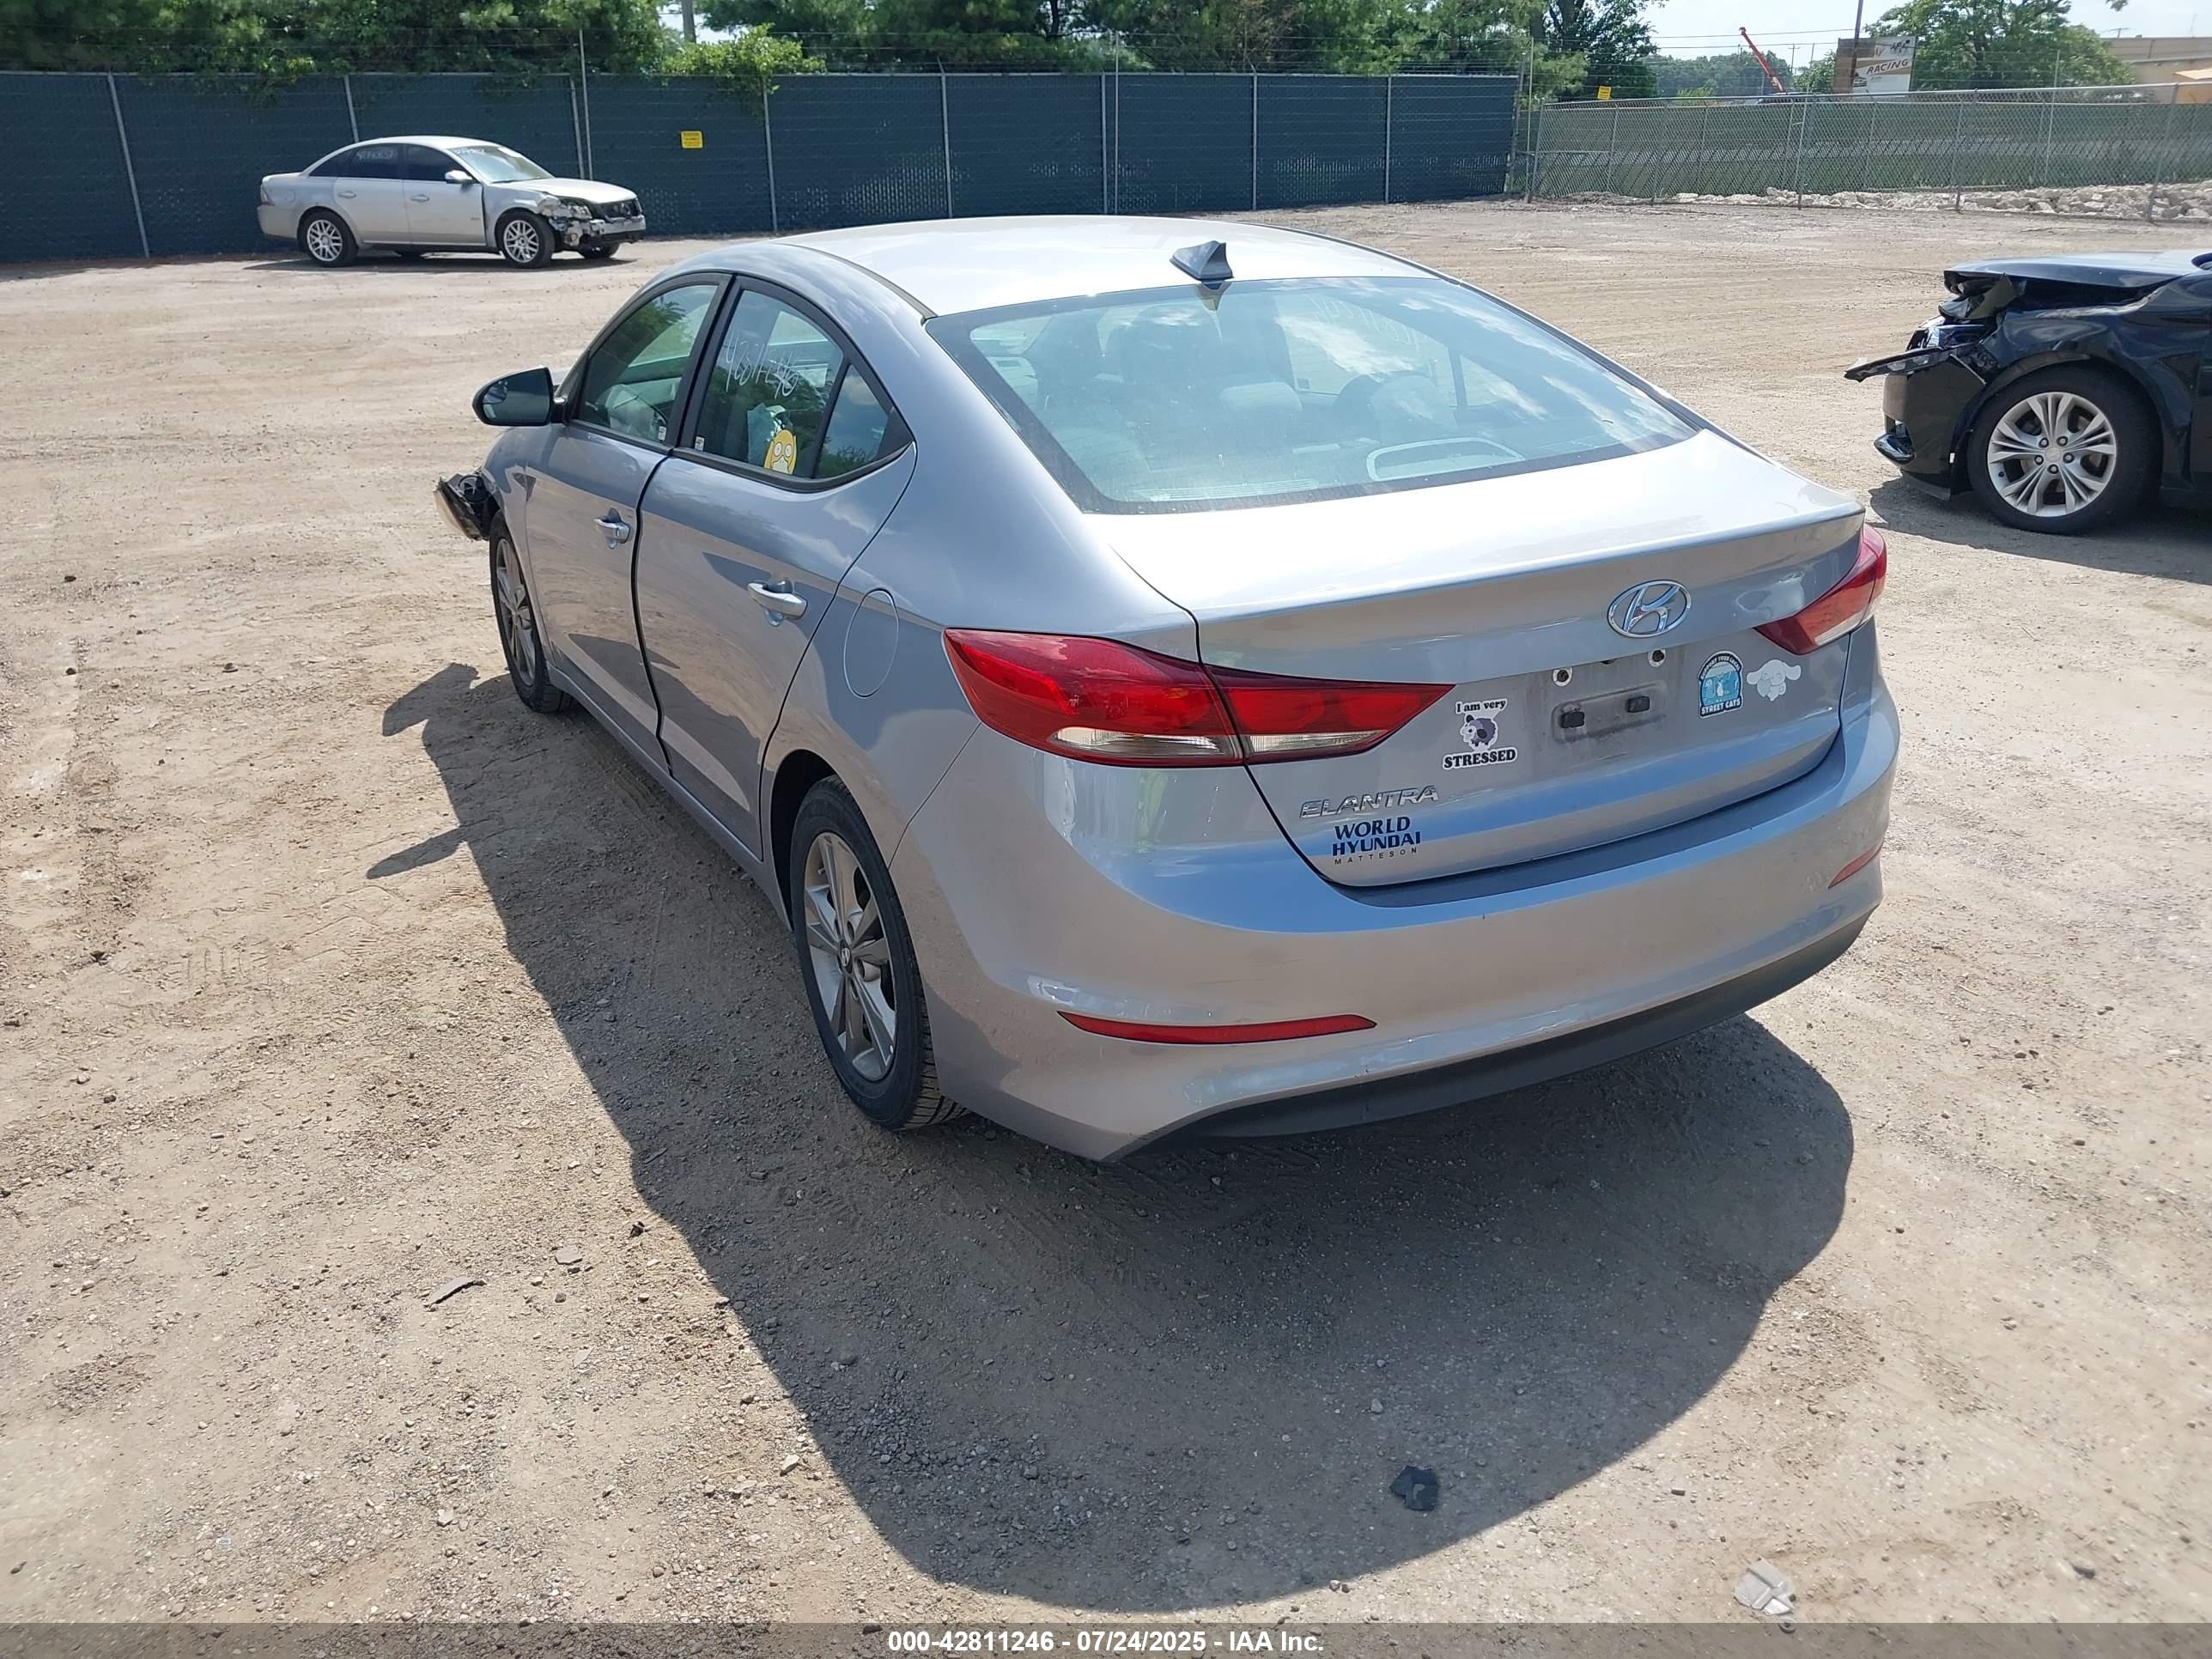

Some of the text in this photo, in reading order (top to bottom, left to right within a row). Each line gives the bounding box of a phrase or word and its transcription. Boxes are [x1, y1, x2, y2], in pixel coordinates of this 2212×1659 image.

[1867, 59, 1909, 75] RACING
[1456, 700, 1506, 713] I am very
[1701, 698, 1741, 714] STREET CATS
[1443, 749, 1516, 769] STRESSED
[1299, 785, 1440, 818] ELANTRA
[1334, 816, 1411, 841] WORLD
[1332, 831, 1421, 856] HYUNDAI
[1334, 848, 1417, 866] MATTESON
